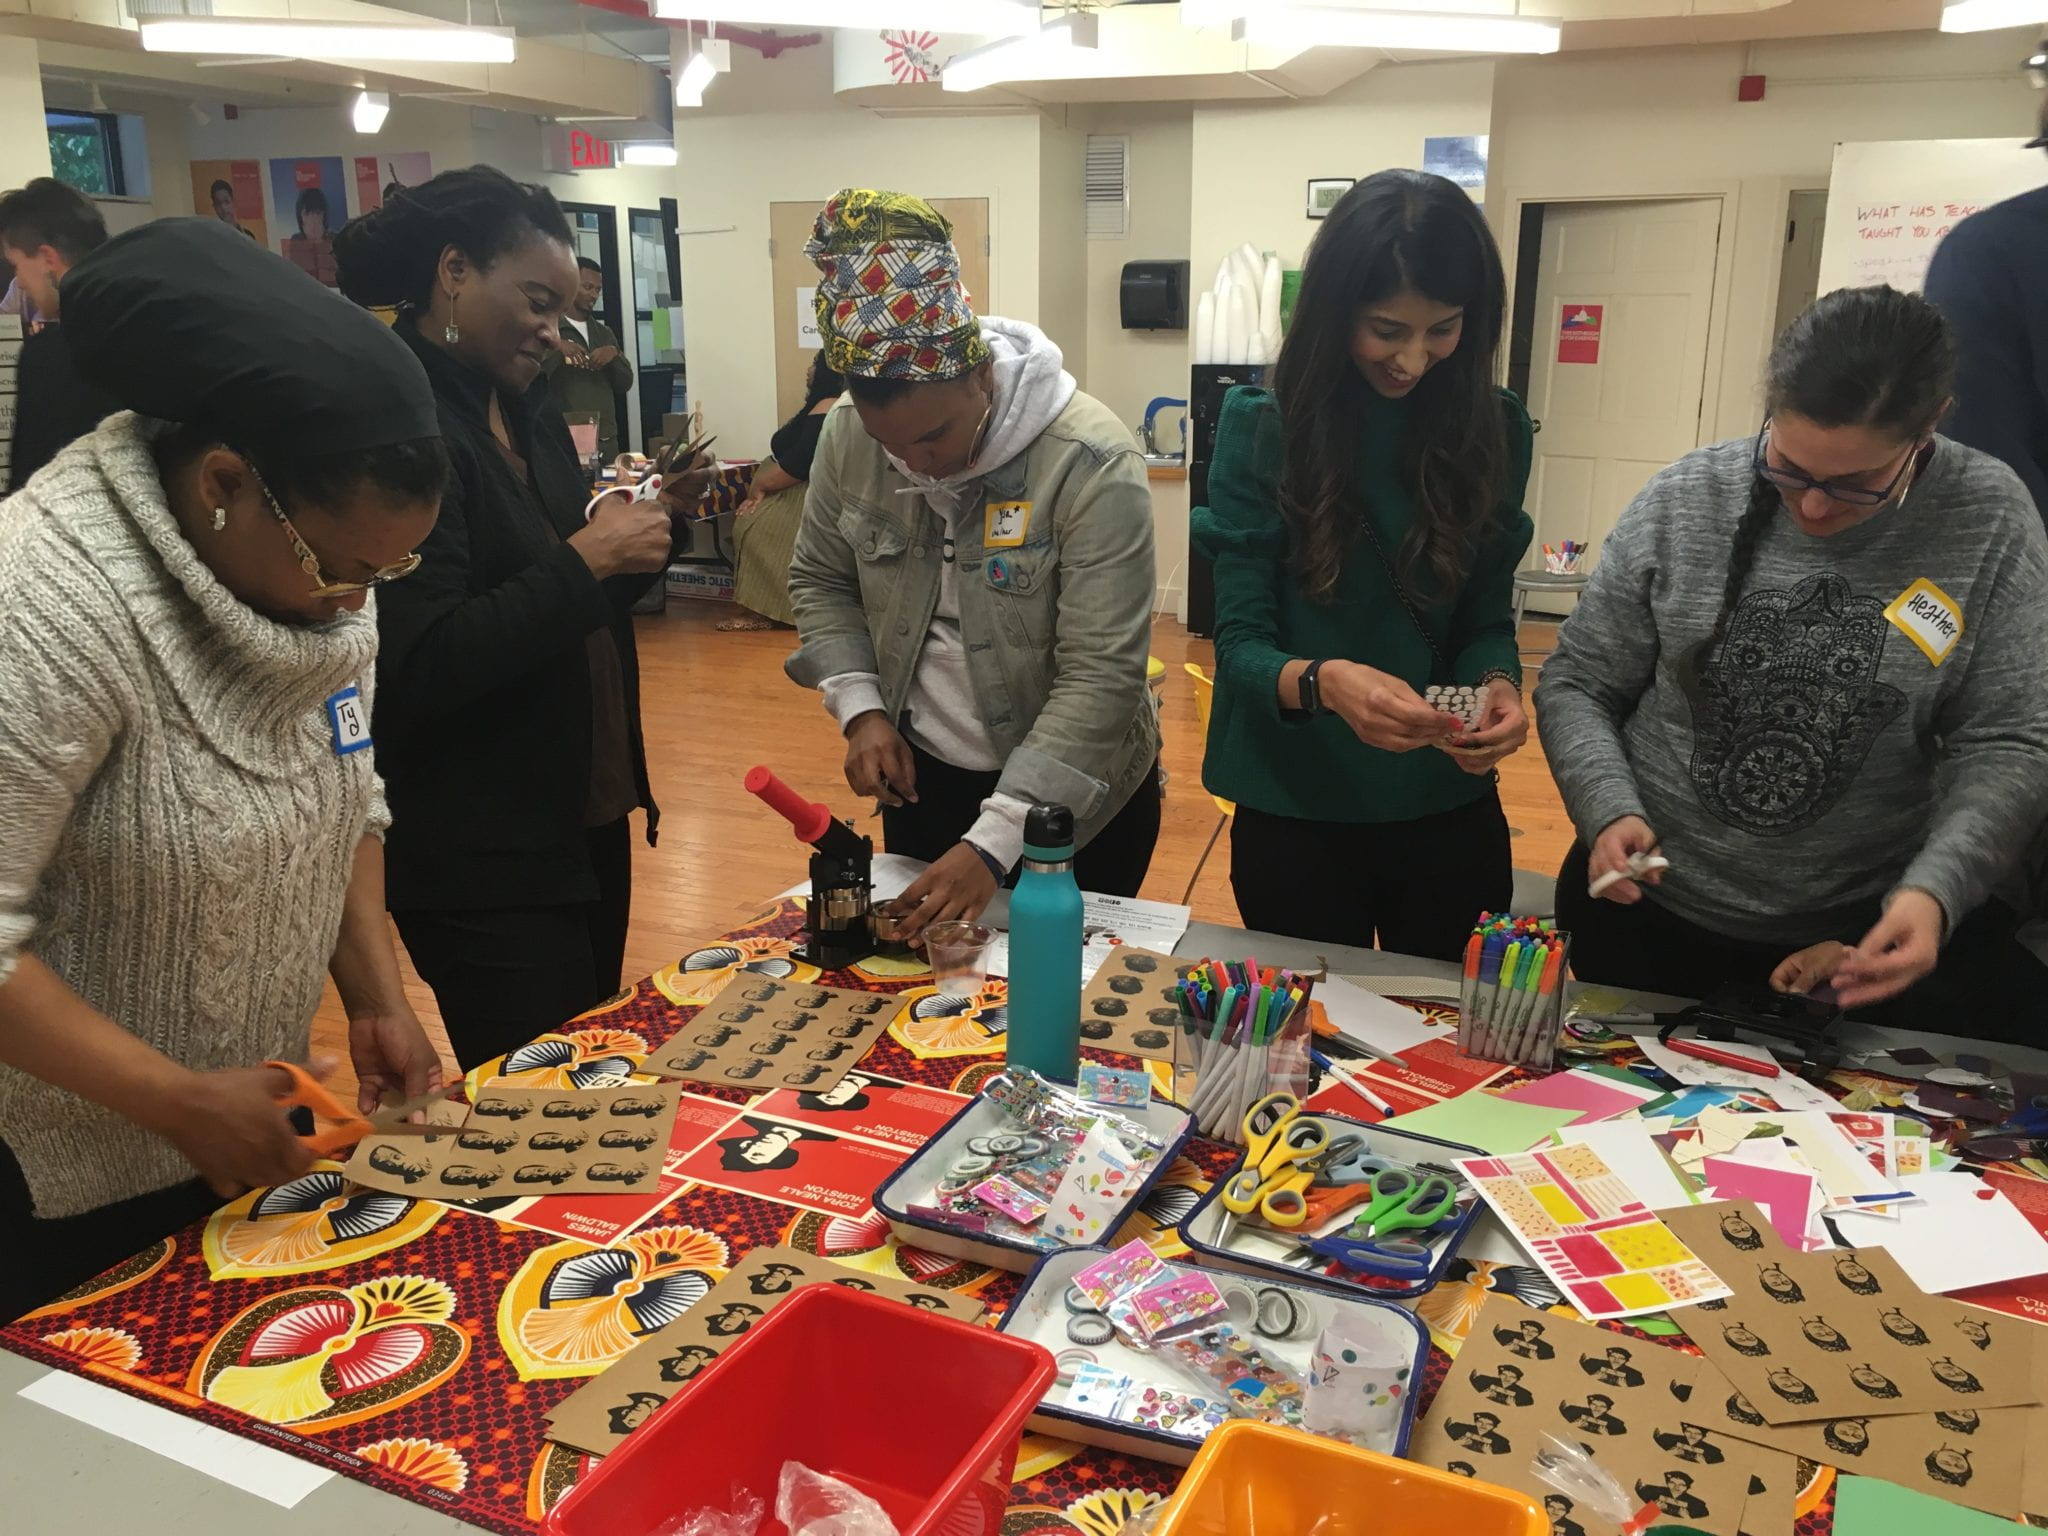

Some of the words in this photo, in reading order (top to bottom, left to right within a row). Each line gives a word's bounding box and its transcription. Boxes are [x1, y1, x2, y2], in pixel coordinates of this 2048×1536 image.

[1857, 205, 1900, 221] WHAT
[1909, 205, 1936, 218] HAS
[1859, 225, 1903, 240] TAUGHT
[1912, 225, 1930, 238] YOU
[1907, 592, 1958, 640] Heather
[336, 702, 360, 737] Ty
[1396, 1068, 1456, 1091] CHISHOLM
[1402, 1076, 1451, 1095] SHIRLEY
[852, 1124, 894, 1140] NEALE
[779, 1185, 824, 1202] NEALE
[803, 1183, 866, 1204] HURSTON
[823, 1196, 859, 1210] ZORA
[562, 1211, 621, 1231] BALDWIN
[566, 1222, 613, 1238] JAMES
[252, 1422, 303, 1445] GUARANTEED
[303, 1440, 331, 1456] DUTCH
[332, 1451, 363, 1468] DESIGN
[427, 1488, 454, 1502] 03464
